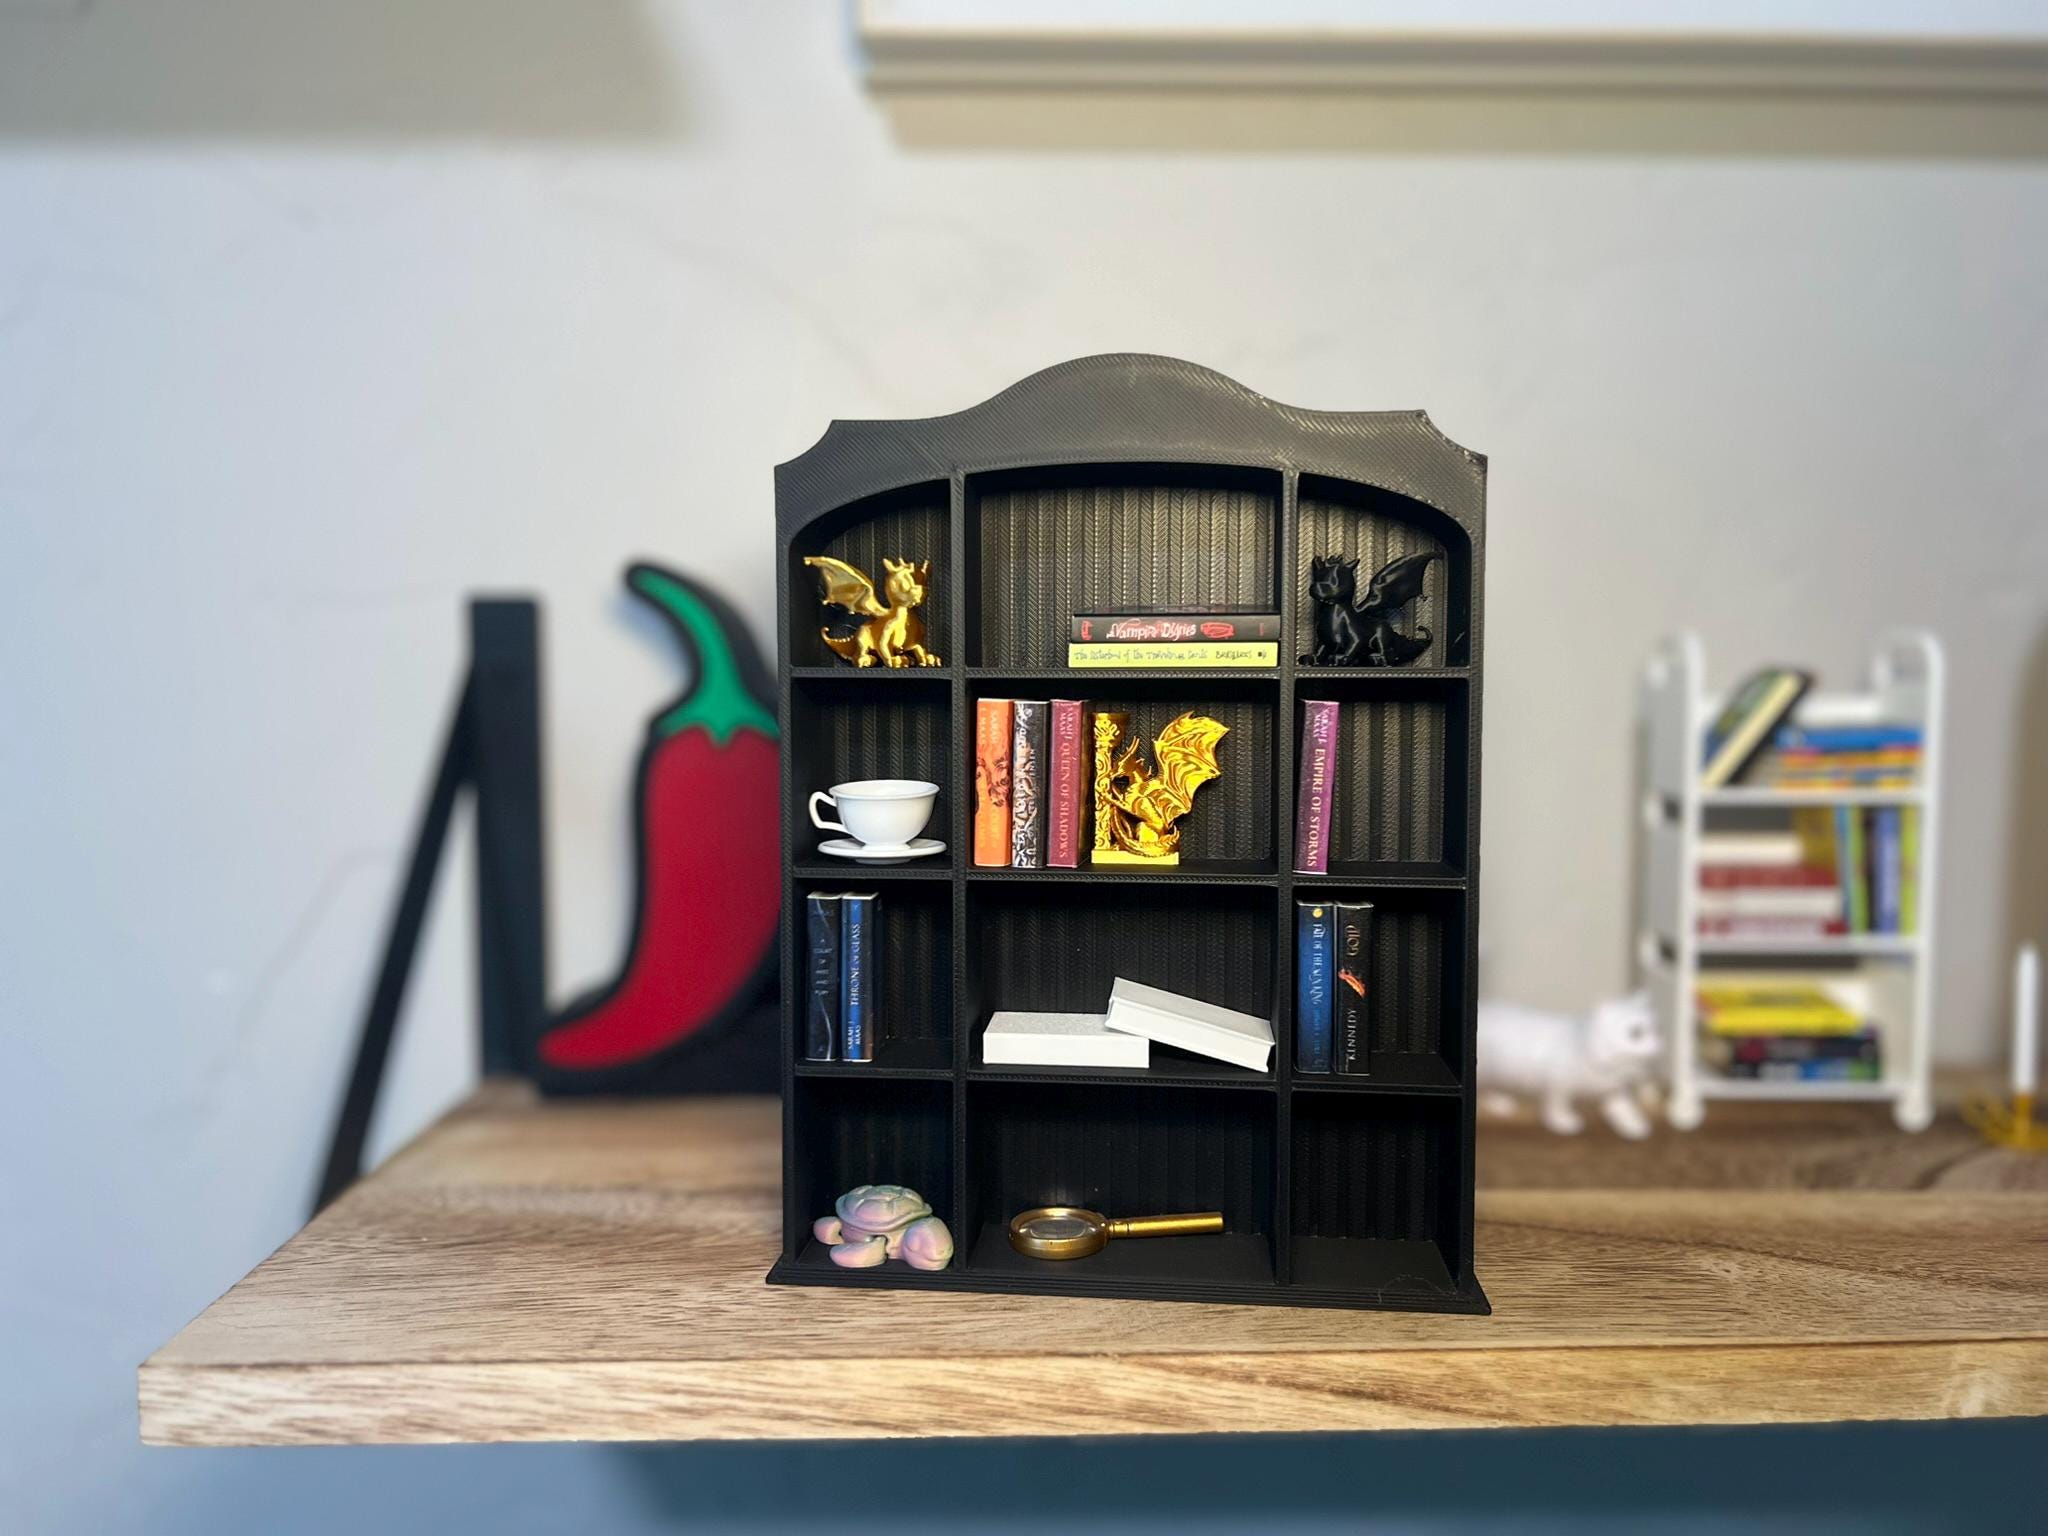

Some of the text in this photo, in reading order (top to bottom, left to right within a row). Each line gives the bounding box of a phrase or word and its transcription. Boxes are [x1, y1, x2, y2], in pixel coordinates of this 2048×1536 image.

[1059, 742, 1071, 858] QUEEN OF SHADOWS
[1307, 748, 1326, 867] EMPIRE OF STORMS
[850, 923, 860, 954] GLASS
[850, 966, 860, 1006] THRONE
[1347, 1009, 1358, 1061] KENNEDY
